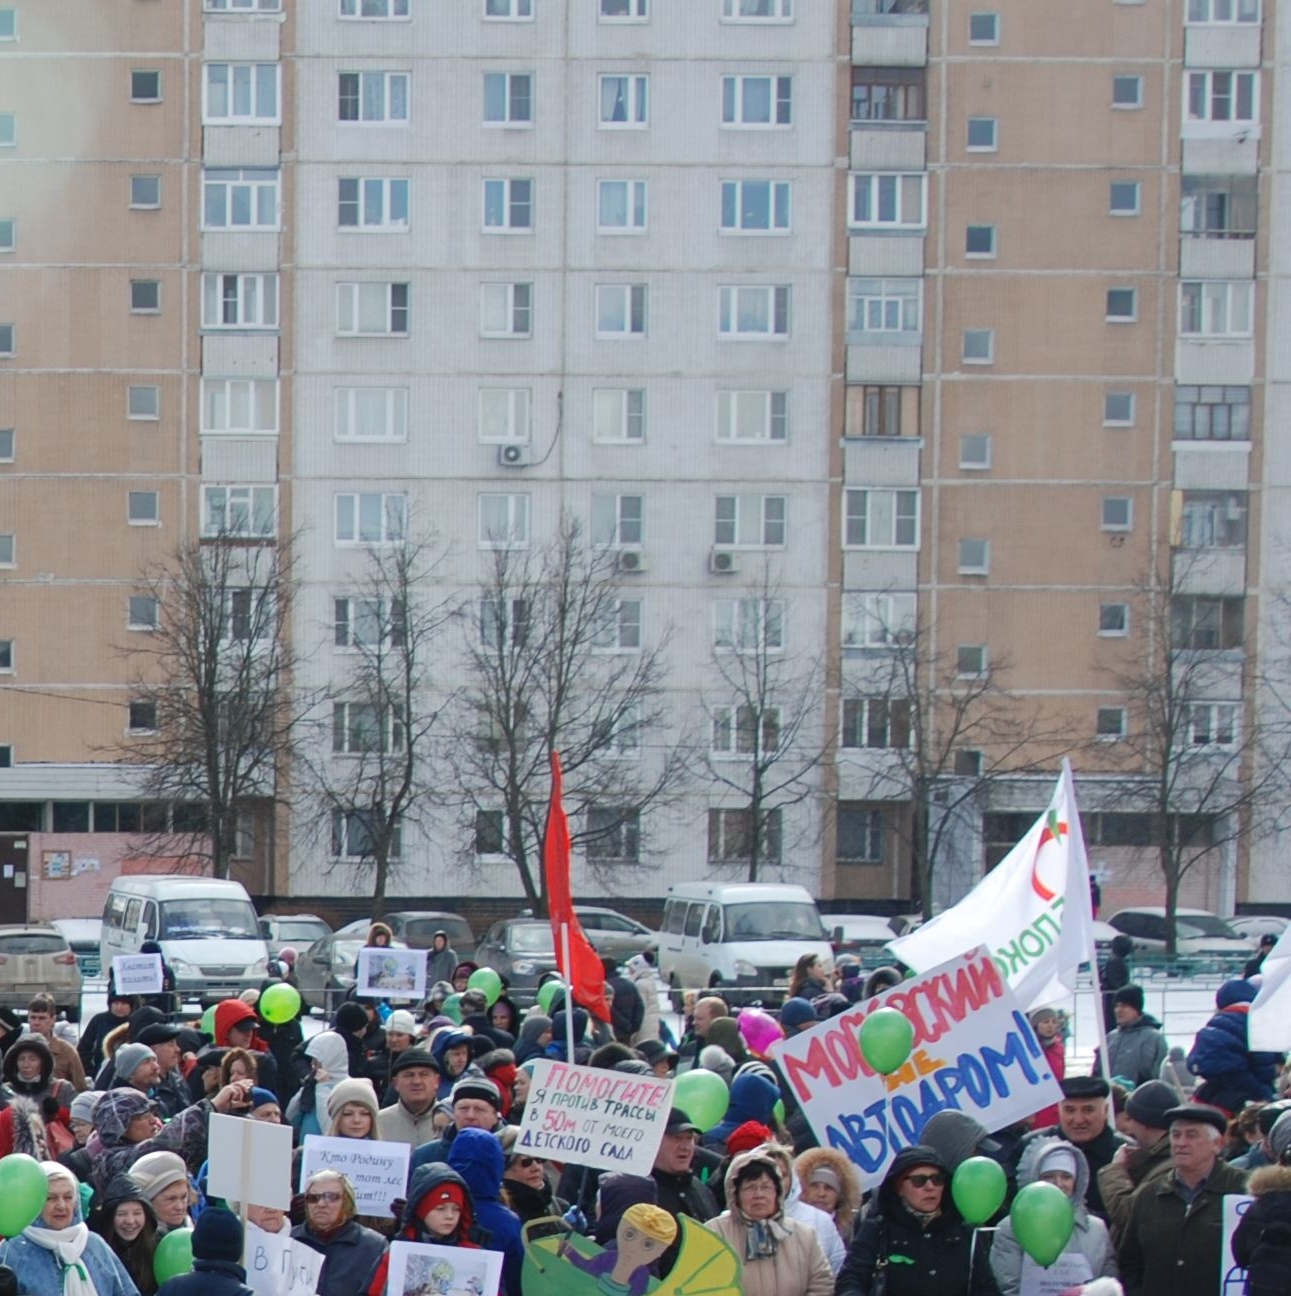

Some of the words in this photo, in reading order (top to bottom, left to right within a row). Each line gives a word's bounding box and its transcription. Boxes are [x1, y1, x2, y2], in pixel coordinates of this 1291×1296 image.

[782, 947, 1005, 1104] МОСВСКИЙ
[545, 1063, 671, 1109] ПОМОГИТЕ!
[531, 1089, 546, 1105] Я
[550, 1092, 599, 1111] ПРОТИВ
[603, 1100, 657, 1122] ТРАССЫ
[350, 1152, 395, 1171] Родину
[520, 1129, 591, 1154] ДЕТСКОГО
[599, 1141, 634, 1161] САДА
